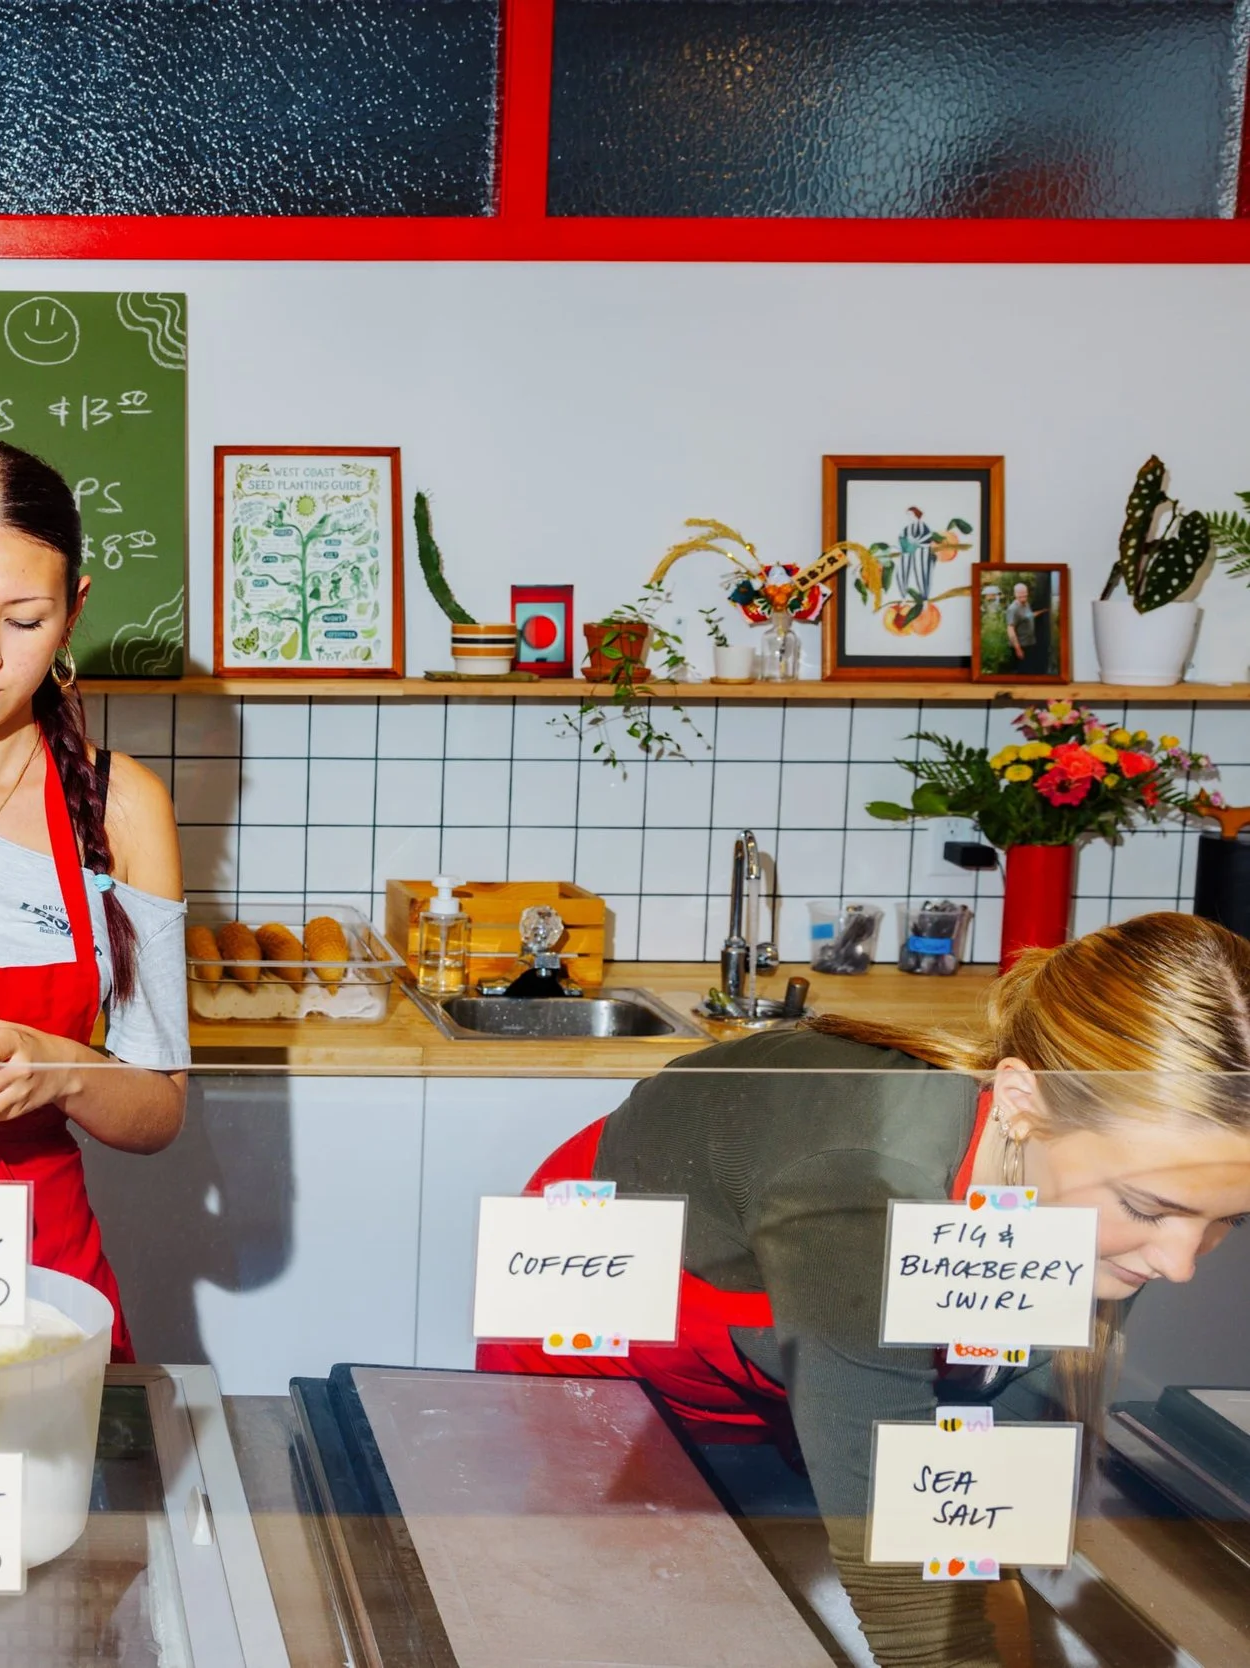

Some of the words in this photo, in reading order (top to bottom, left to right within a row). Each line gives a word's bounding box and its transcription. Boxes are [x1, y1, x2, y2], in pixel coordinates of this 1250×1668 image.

[273, 468, 300, 477] WEST
[303, 468, 335, 477] COAST
[249, 481, 275, 490] SEED
[278, 481, 328, 490] PLANTING
[331, 481, 361, 490] GUIDE
[933, 1223, 986, 1248] FIG
[998, 1224, 1014, 1248] &
[509, 1252, 634, 1277] COFFEE
[900, 1255, 1083, 1285] BLACKBERRY
[937, 1290, 1033, 1310] SWIRL
[914, 1465, 977, 1495] SEA
[933, 1500, 1013, 1529] SALT
